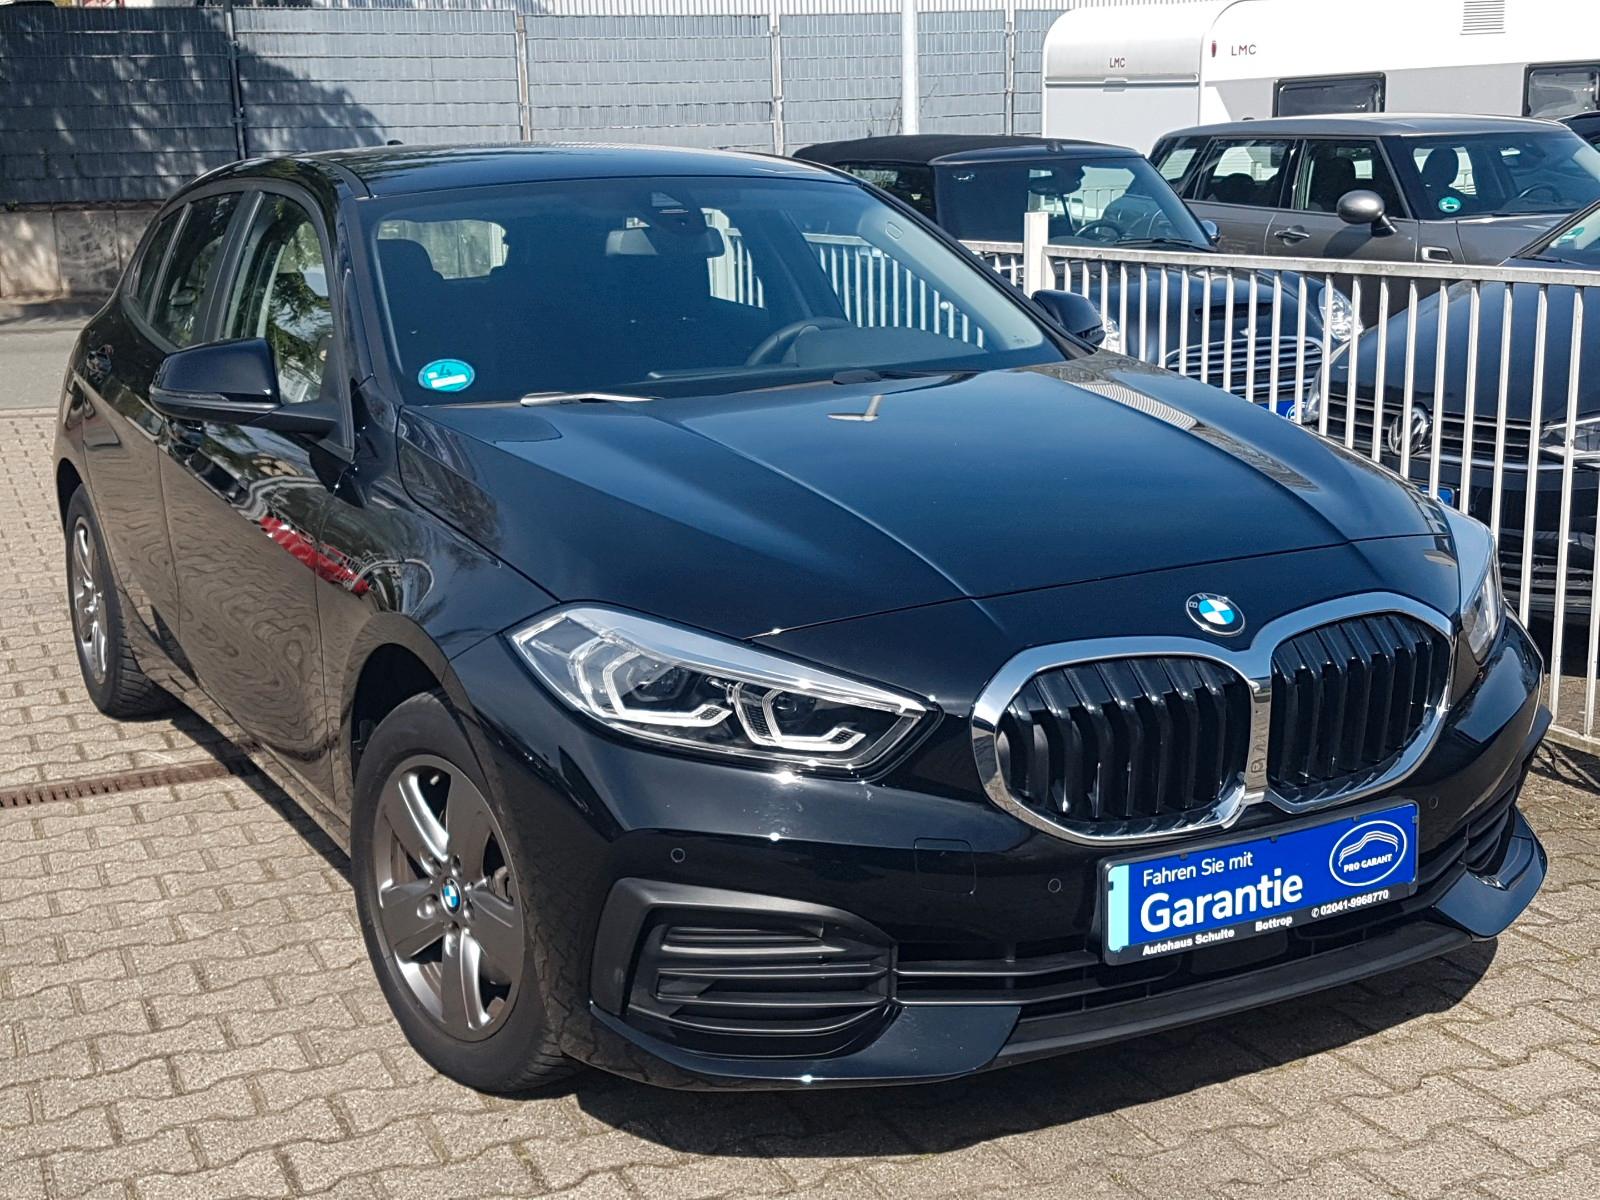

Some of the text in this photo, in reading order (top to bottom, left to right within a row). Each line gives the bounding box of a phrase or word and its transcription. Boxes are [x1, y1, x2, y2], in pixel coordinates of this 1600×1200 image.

[1231, 44, 1256, 56] LMC
[1109, 57, 1126, 68] LMC
[1143, 851, 1253, 887] Fahren Sie mit
[1343, 853, 1393, 873] PRO GARANT
[1140, 868, 1303, 933] Garantie
[1320, 889, 1389, 916] 02041-9968770
[1255, 915, 1293, 932] Bottrop
[1142, 928, 1235, 956] Autohaus Schulte
